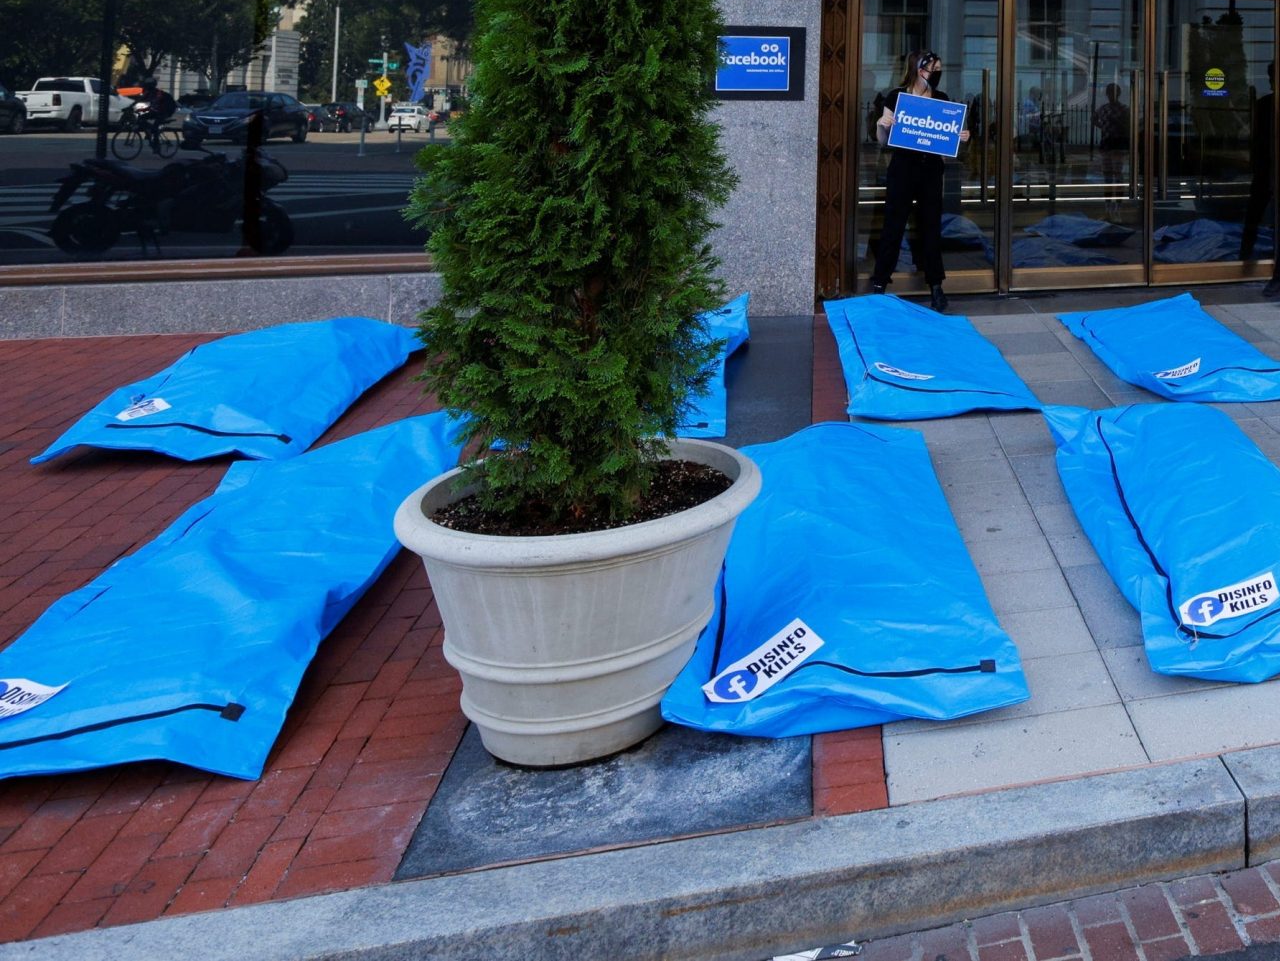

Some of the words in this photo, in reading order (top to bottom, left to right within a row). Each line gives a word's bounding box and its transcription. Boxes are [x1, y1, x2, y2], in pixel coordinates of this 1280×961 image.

[897, 110, 960, 133] facebook
[901, 127, 950, 141] Disinformation
[1218, 580, 1272, 604] DISINFO
[1229, 594, 1268, 612] KILLS
[746, 627, 806, 675] DISINFO
[762, 642, 806, 679] KILLS
